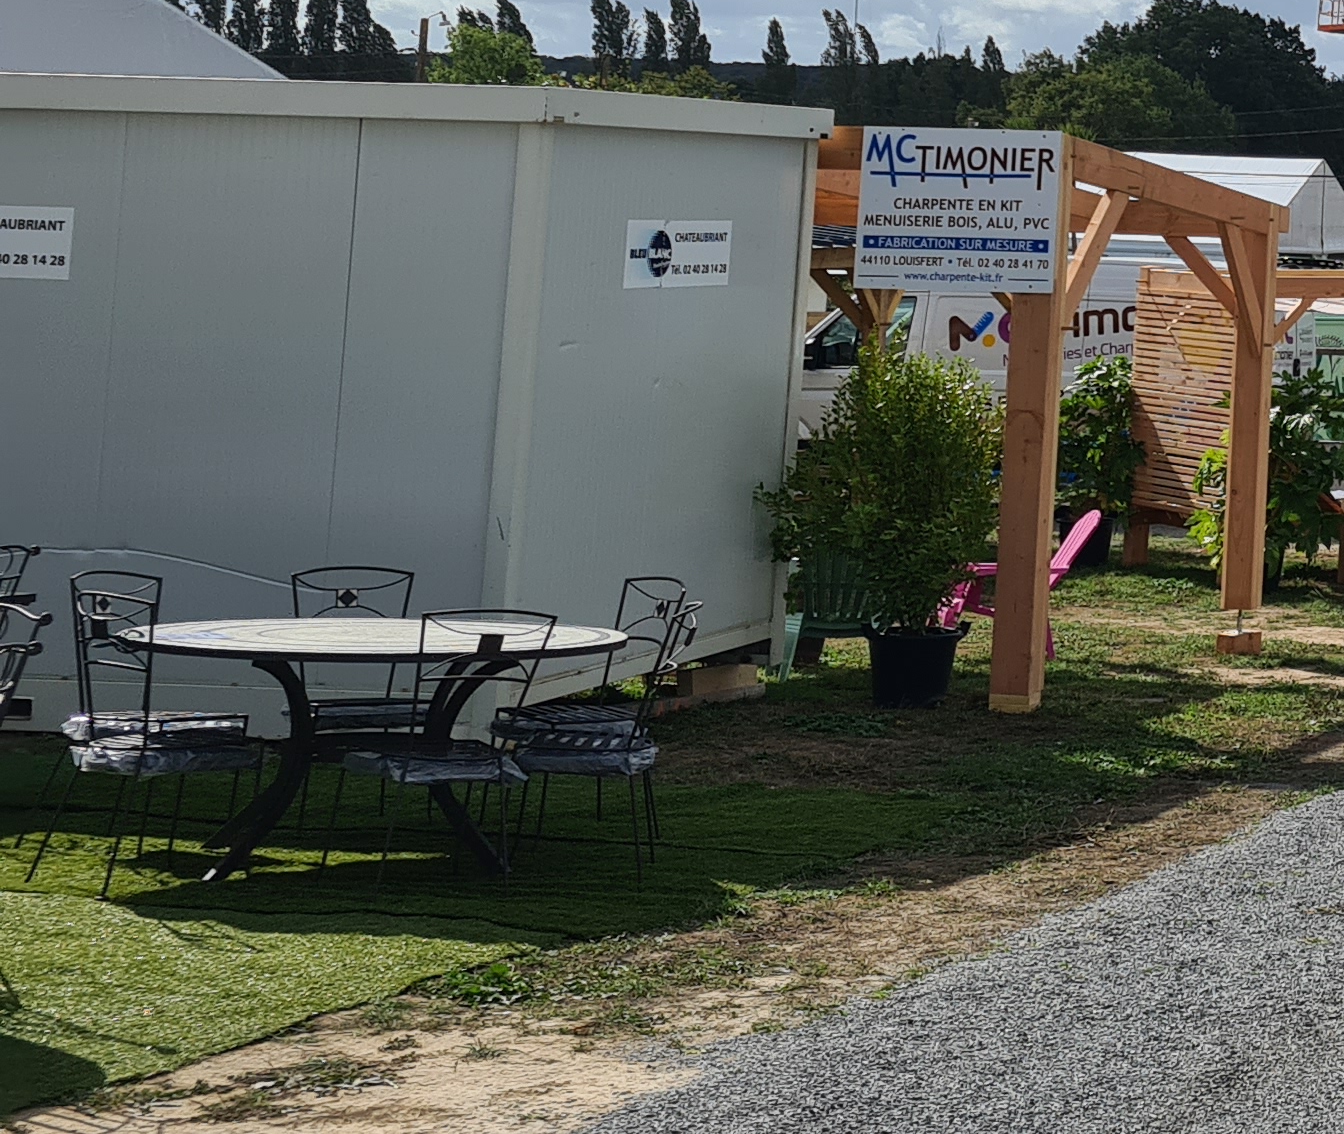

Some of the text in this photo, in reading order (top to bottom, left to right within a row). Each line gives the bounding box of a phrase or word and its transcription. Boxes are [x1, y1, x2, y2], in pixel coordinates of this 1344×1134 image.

[894, 198, 1023, 212] CHARPENTE EN KIT
[0, 218, 66, 231] AUBRIANT
[863, 214, 1050, 231] MENUISERIE BOIS, ALU, PVC
[674, 231, 729, 243] CHATEAUBRIANT
[877, 237, 1034, 252] FABRICATION SUR MESURE
[13, 253, 28, 265] 28
[32, 254, 47, 265] 14
[49, 255, 66, 266] 28
[861, 255, 1049, 270] 44110 LOUISFERT Tél. 02 40 28 41 70
[683, 264, 692, 275] 02
[692, 264, 701, 274] 40
[701, 264, 710, 274] 28
[711, 263, 719, 274] 14
[719, 263, 728, 273] 28
[904, 270, 1004, 284] www.charpente-kit.fr
[1085, 345, 1098, 357] et
[1100, 342, 1134, 356] Char
